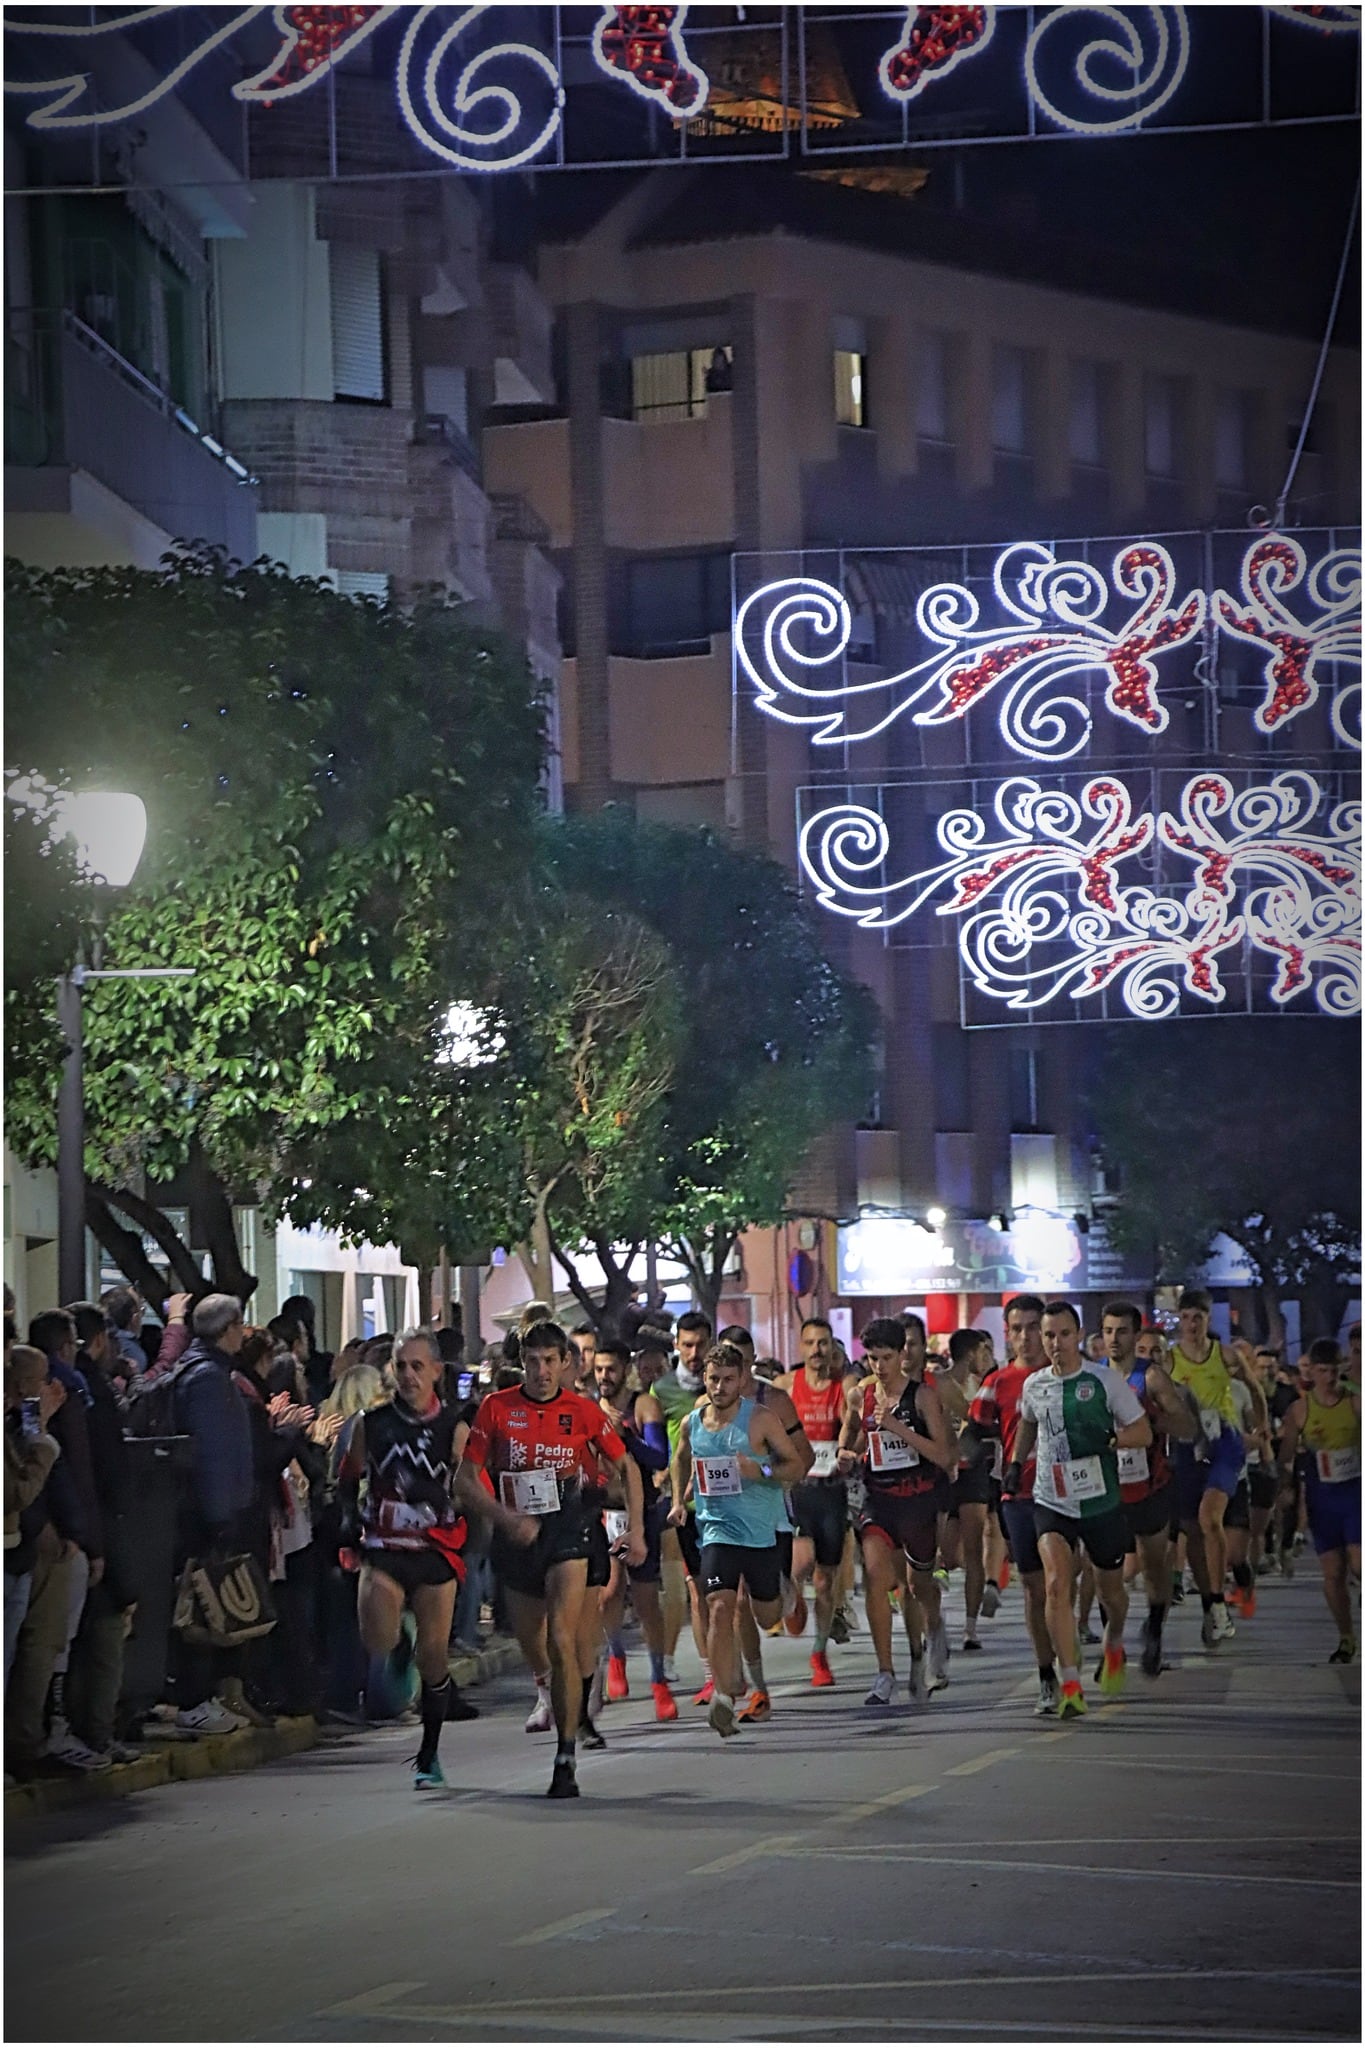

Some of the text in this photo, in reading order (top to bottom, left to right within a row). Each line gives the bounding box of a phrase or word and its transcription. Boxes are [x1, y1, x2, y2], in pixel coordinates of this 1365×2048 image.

[535, 1443, 574, 1457] Pedro
[883, 1440, 908, 1451] 1415
[708, 1468, 730, 1480] 396
[1072, 1469, 1088, 1481] 56
[529, 1484, 536, 1496] 1
